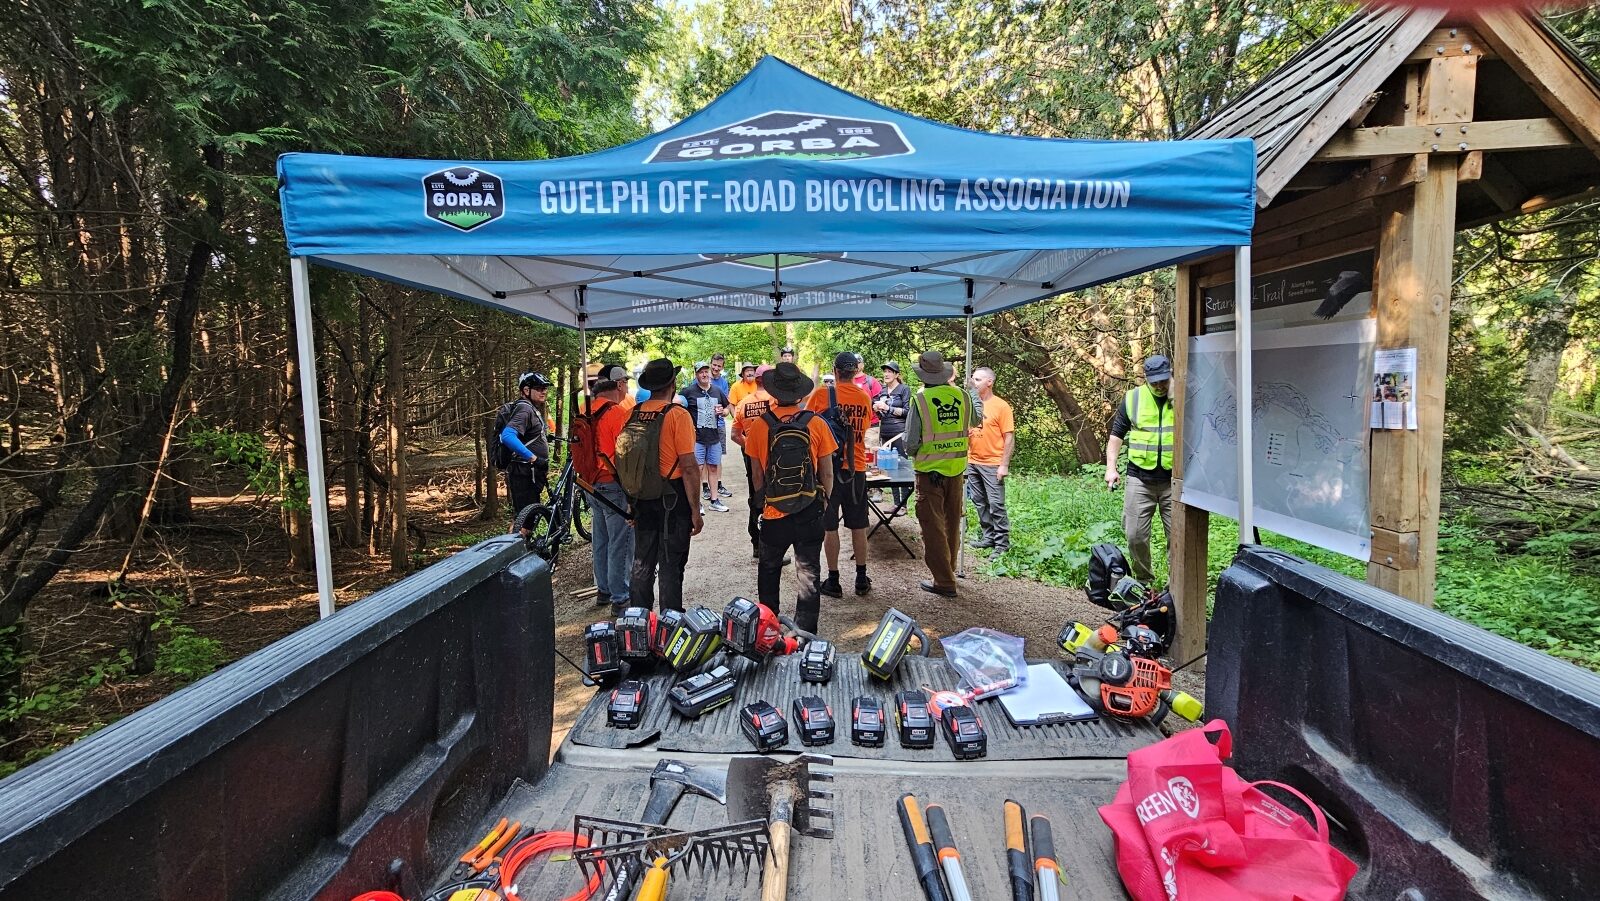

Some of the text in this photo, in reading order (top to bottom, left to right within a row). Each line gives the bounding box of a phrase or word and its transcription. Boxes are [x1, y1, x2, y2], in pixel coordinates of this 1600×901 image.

[677, 136, 881, 158] GORBA
[433, 192, 497, 207] GORBA
[539, 178, 1131, 214] GUELPH OFF-ROAD BICYCLING ASSOCIATION
[1205, 296, 1236, 313] Rotary
[1257, 279, 1286, 303] Trail
[746, 401, 767, 410] TRAIL
[746, 409, 767, 417] CREW
